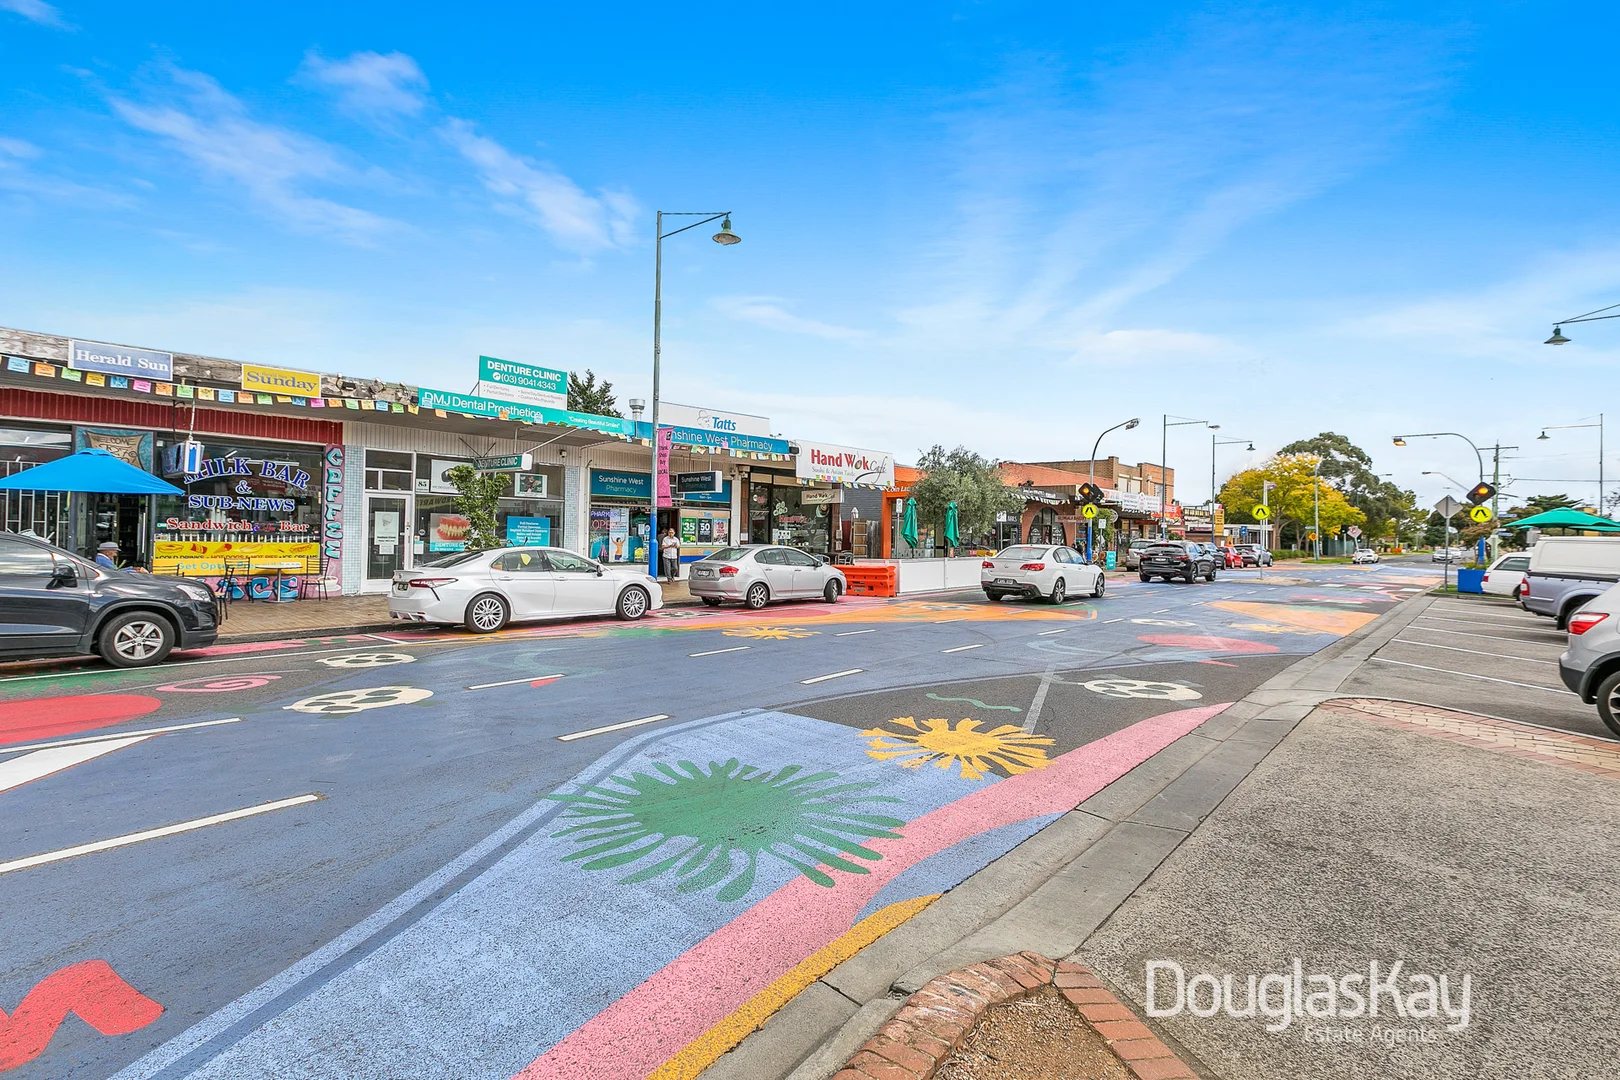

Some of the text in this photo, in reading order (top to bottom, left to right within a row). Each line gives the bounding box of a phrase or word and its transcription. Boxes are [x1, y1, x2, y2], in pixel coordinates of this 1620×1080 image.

[75, 349, 169, 372] Herald Sun
[487, 360, 562, 382] DENTURE CLINIC
[501, 373, 517, 385] (03)
[247, 370, 317, 392] Sunday
[424, 392, 450, 406] DMJ
[452, 396, 486, 411] Dental
[712, 416, 737, 431] Tatts
[92, 436, 137, 446] WELCOME
[671, 430, 773, 451] nshine West Pharmacy
[500, 456, 518, 466] CLINIC
[811, 449, 888, 484] Hand Wok Café
[259, 460, 310, 489] BAR
[598, 475, 644, 486] Sunshine West
[235, 480, 252, 494] &
[606, 484, 636, 494] Pharmacy
[188, 495, 296, 512] SUB-NEWS
[166, 517, 253, 533] Sandwich
[279, 520, 310, 532] Bar
